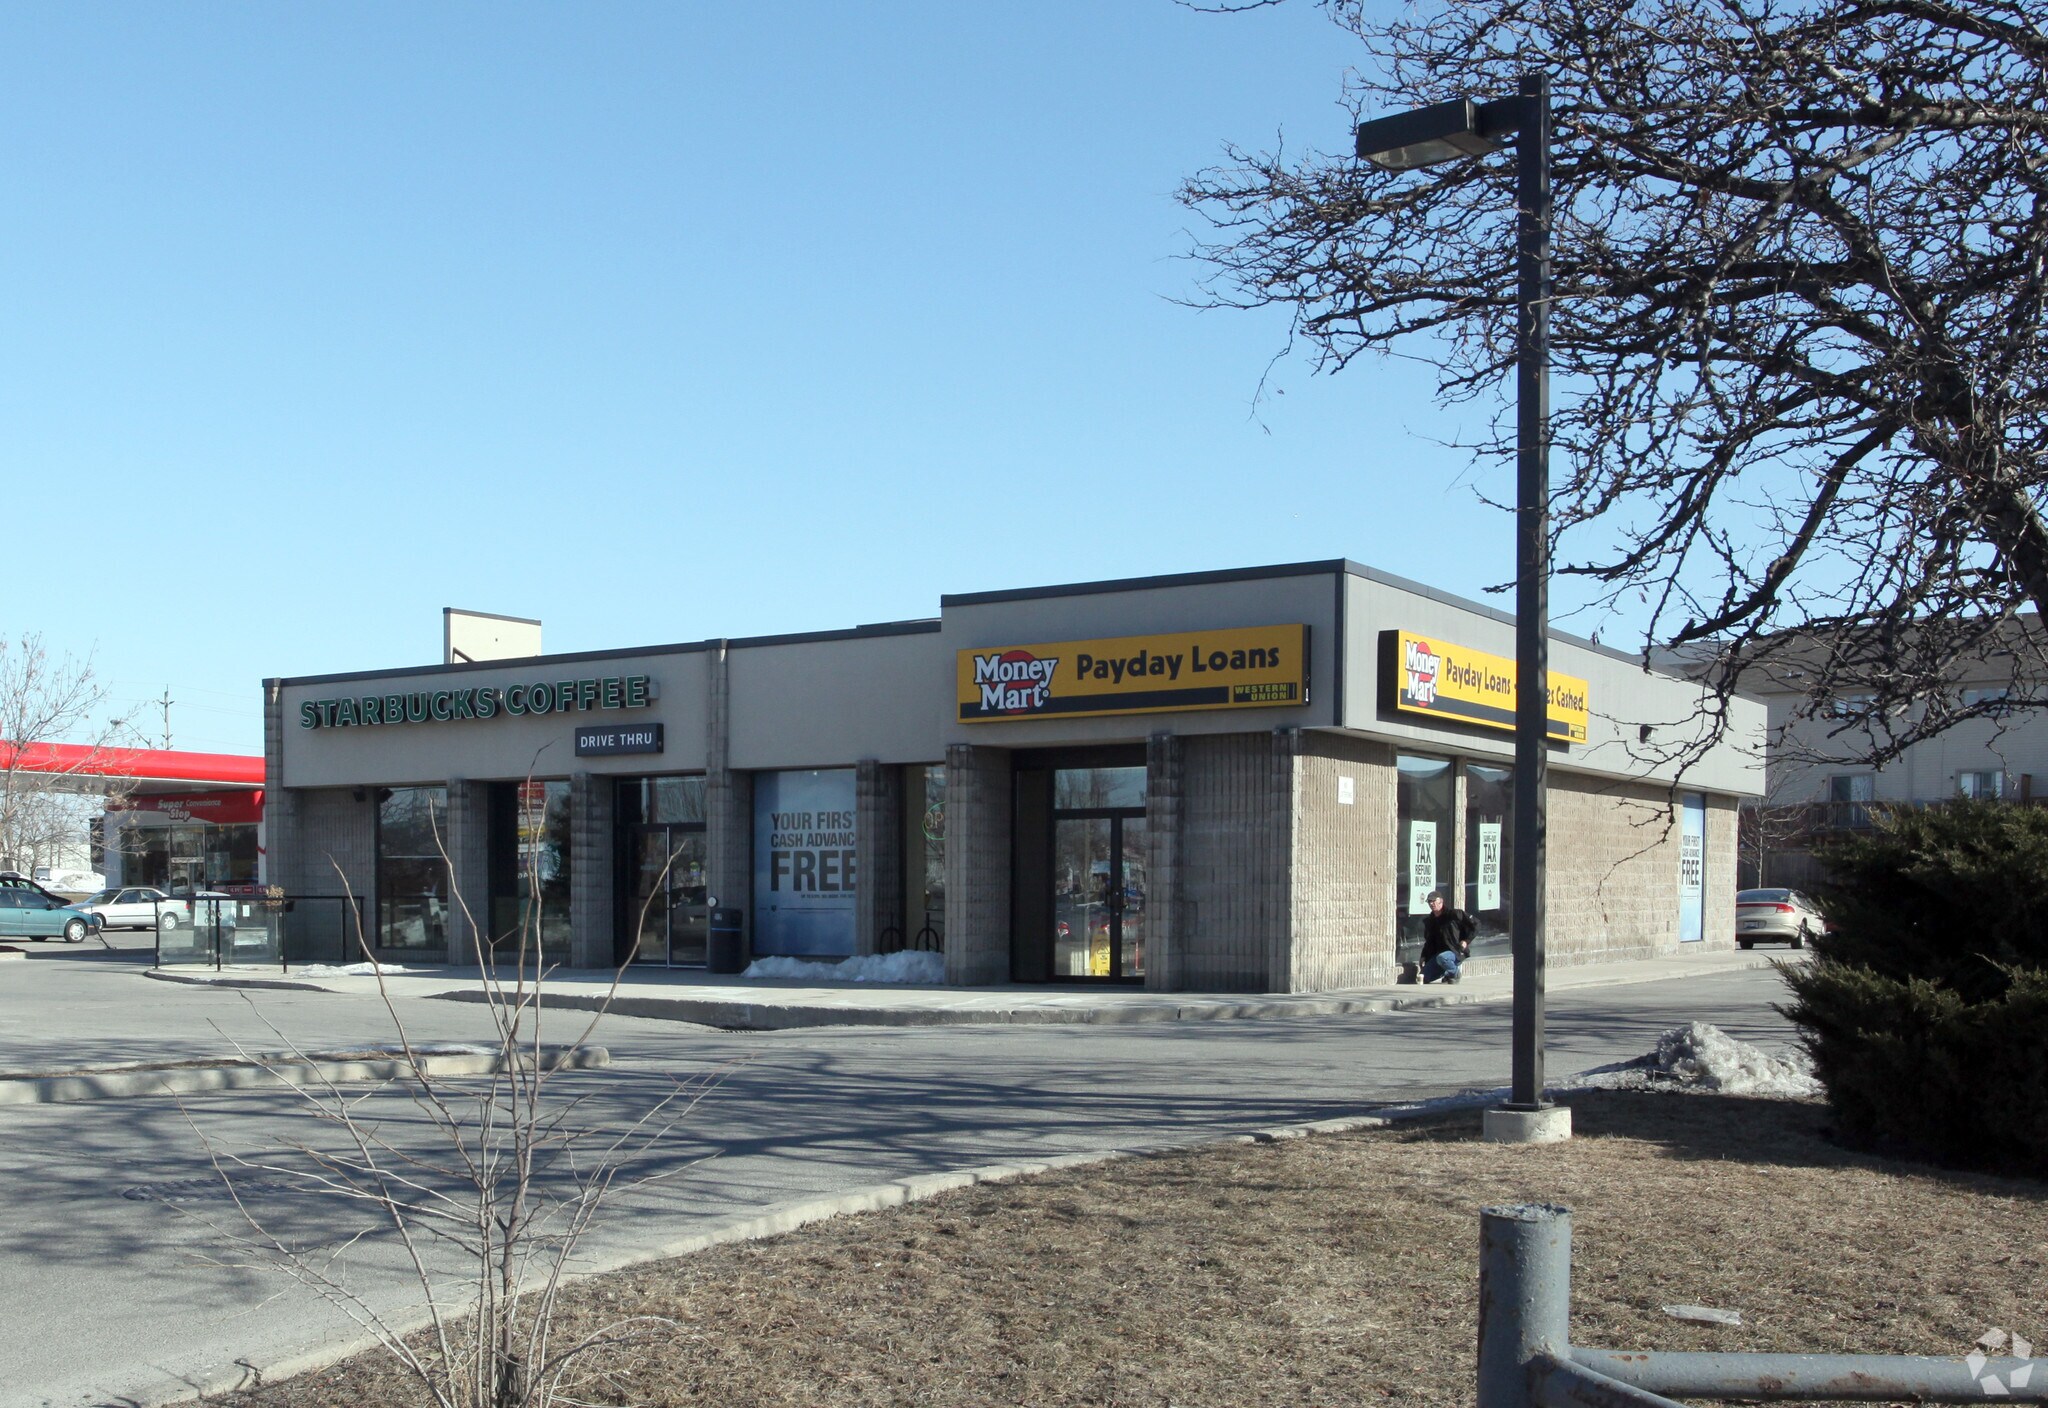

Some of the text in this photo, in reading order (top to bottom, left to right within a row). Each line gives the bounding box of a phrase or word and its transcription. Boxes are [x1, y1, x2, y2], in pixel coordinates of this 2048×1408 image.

[974, 654, 1058, 688] Money
[1076, 646, 1280, 684] Payday Loans
[1405, 640, 1441, 684] Money
[1234, 684, 1287, 694] WESTERN
[1407, 671, 1435, 703] Mart
[1446, 657, 1482, 693] Payday
[1484, 666, 1511, 695] Loans
[1556, 685, 1584, 712] Cashed
[300, 675, 646, 730] STARBUCKS COFFEE
[980, 683, 1044, 711] Mart
[1251, 692, 1287, 701] UNION
[580, 732, 652, 748] DRIVE THRU
[157, 799, 222, 811] Super Convenience
[169, 808, 191, 820] Stop
[771, 811, 856, 831] YOUR FIRS
[771, 831, 855, 848] CASH ADVANC
[1416, 842, 1431, 863] TAX
[1484, 843, 1497, 863] TAX
[771, 850, 856, 892] FREE
[1415, 864, 1432, 875] REFUND
[1682, 860, 1699, 885] FREE
